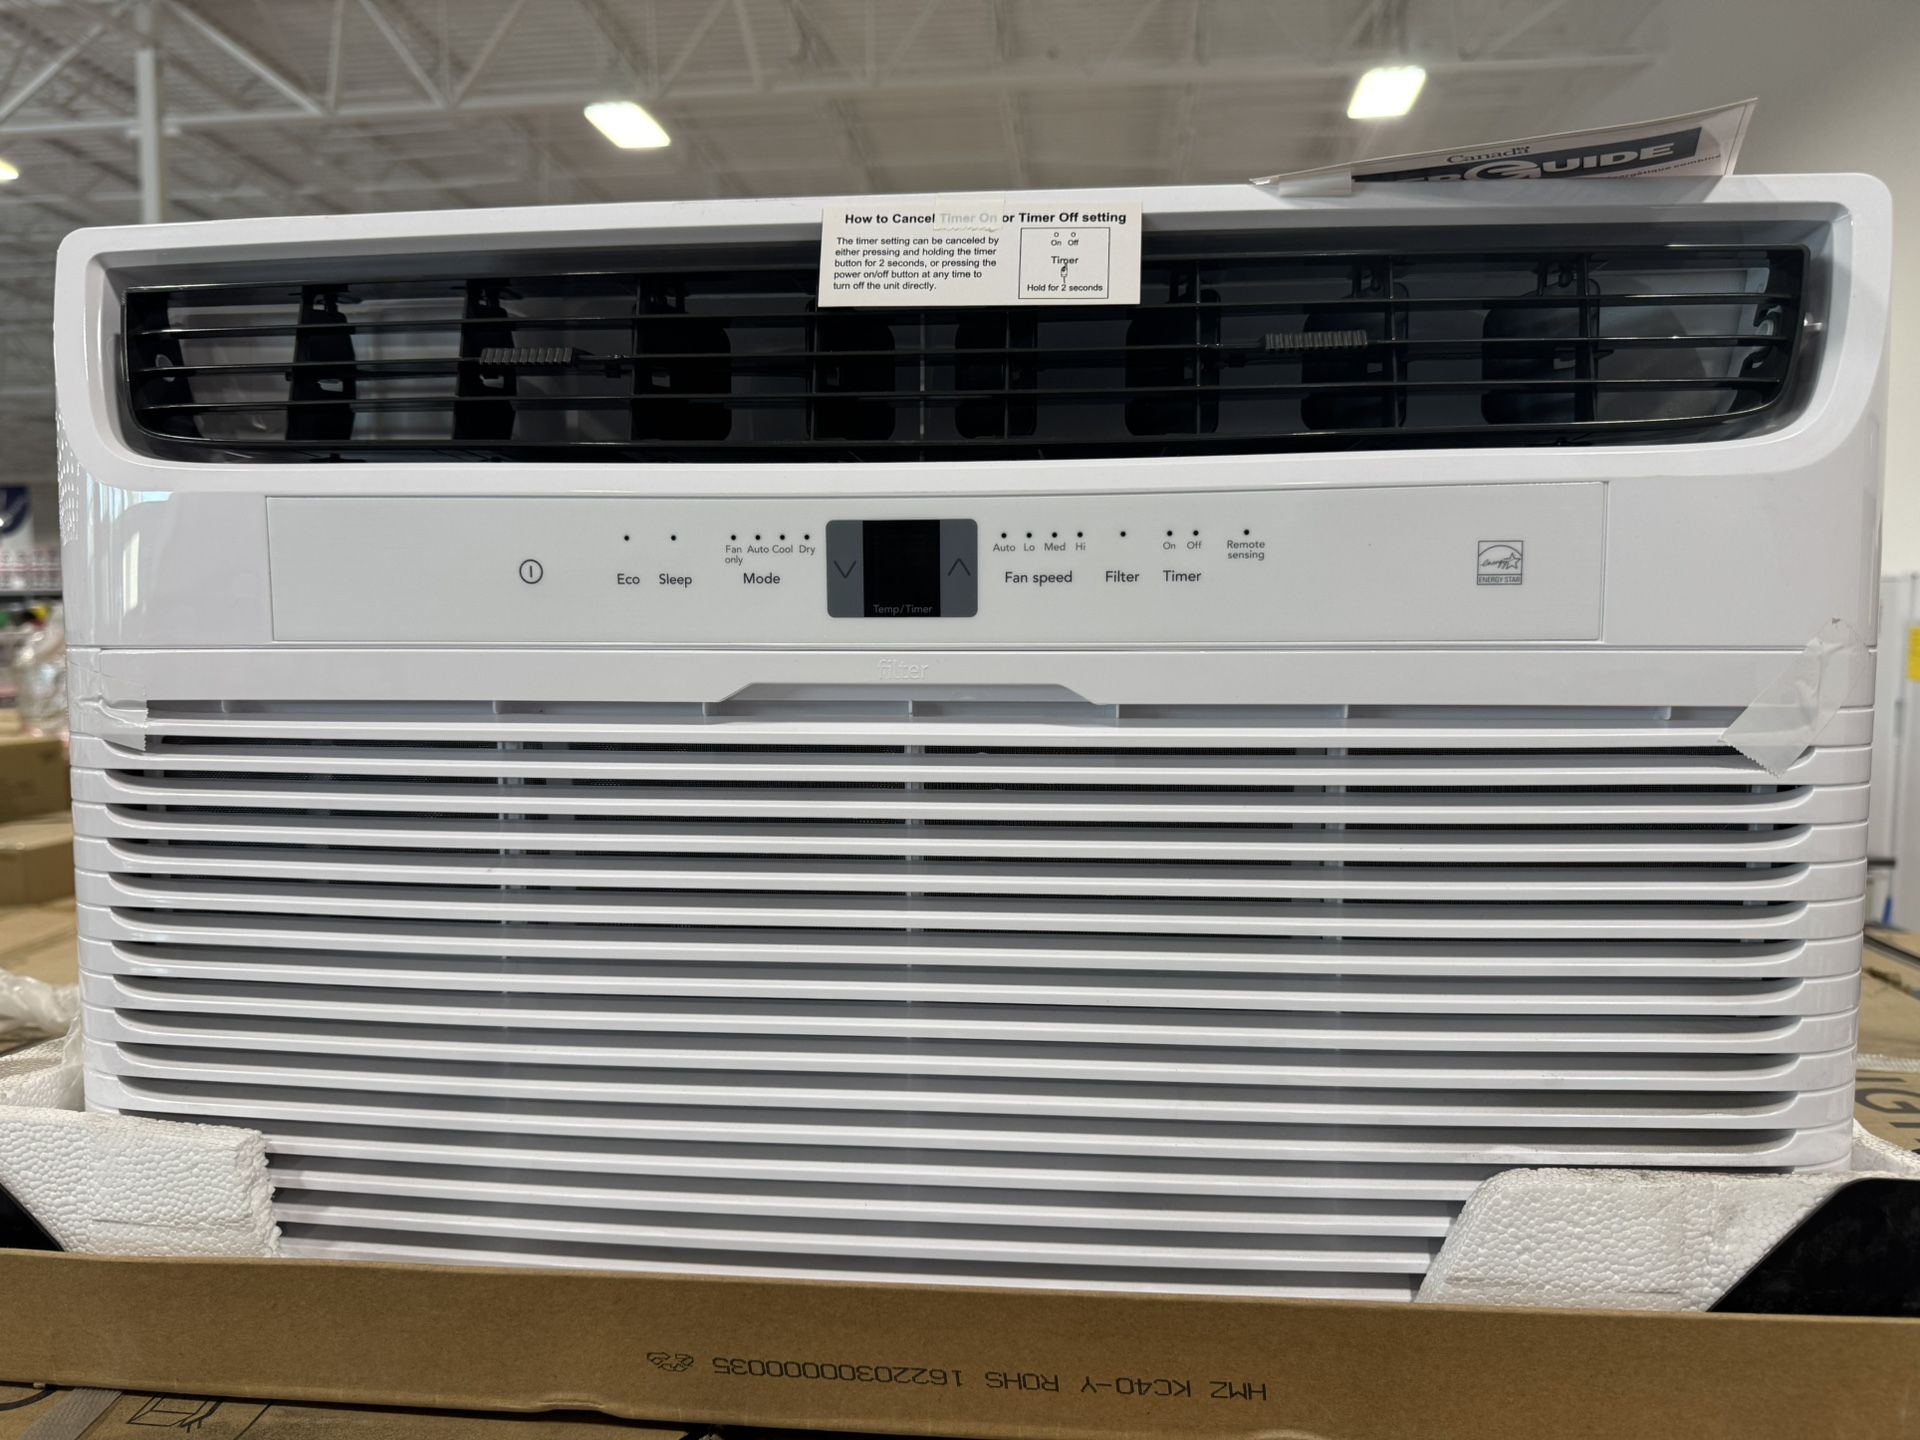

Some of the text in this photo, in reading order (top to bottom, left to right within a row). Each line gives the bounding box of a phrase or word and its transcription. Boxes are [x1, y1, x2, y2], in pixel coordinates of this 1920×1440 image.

[845, 212, 1127, 225] How to Cancel Timer On or Timer Off setting
[836, 237, 853, 246] The
[856, 237, 878, 245] timer
[880, 237, 910, 247] setting
[931, 237, 943, 245] be
[945, 237, 986, 246] canceled
[988, 236, 999, 247] by
[835, 247, 997, 258] either pressing and holding the timer
[834, 258, 862, 267] button
[864, 258, 877, 267] for
[878, 259, 885, 267] 2
[887, 258, 928, 269] seconds,
[941, 259, 980, 269] pressing
[982, 258, 997, 267] the
[1051, 256, 1079, 264] Timer
[833, 270, 983, 280] power on/off button at any time to
[833, 281, 937, 291] turn off the unit directly.
[1027, 284, 1103, 292] Hold for 2 seconds
[993, 542, 1086, 552] Auto Lo Med Hi
[1162, 541, 1202, 550] On Off
[1226, 540, 1265, 549] Remote
[725, 545, 816, 556] Fan Auto Cool Dry
[1227, 550, 1265, 561] sensing
[725, 555, 743, 566] only
[617, 573, 641, 585] Eco
[658, 573, 693, 588] Sleep
[743, 572, 781, 584] Mode
[1005, 570, 1073, 587] Fan speed
[1105, 570, 1140, 583] Filter
[1162, 570, 1201, 582] Timer
[878, 657, 929, 680] filter
[712, 1357, 1267, 1401] HMZ KC40-Y ROHS 16220300000035
